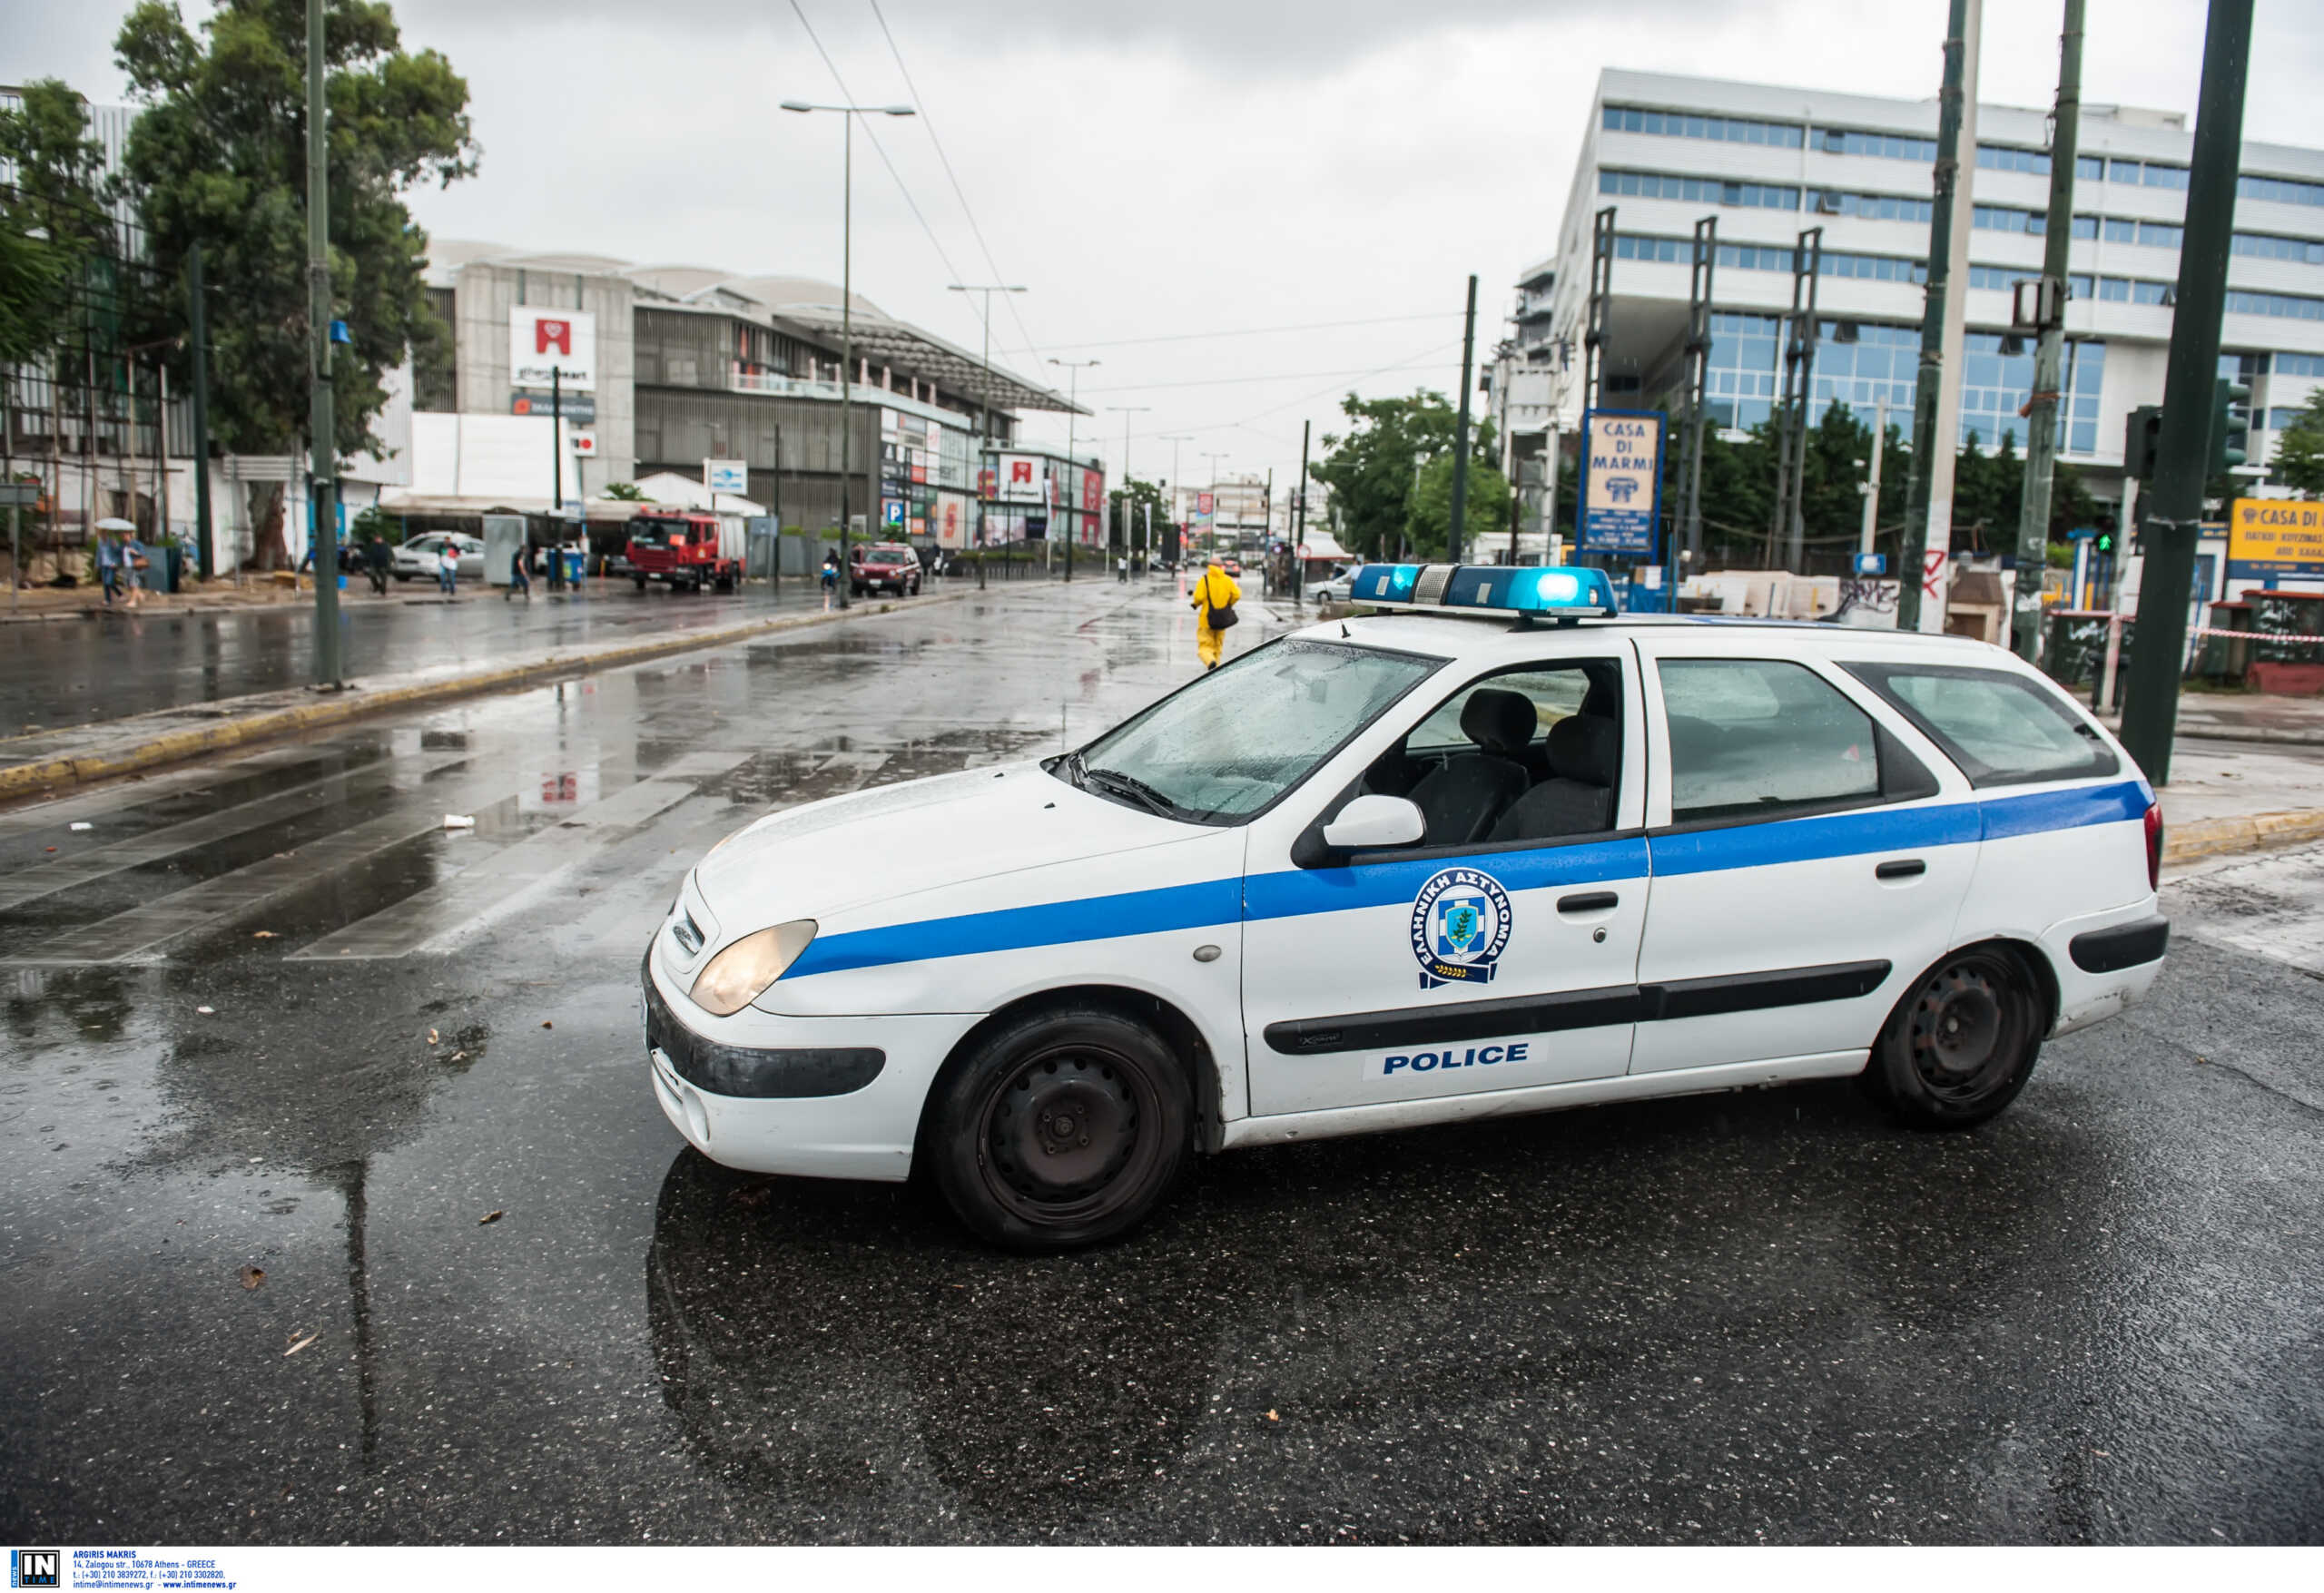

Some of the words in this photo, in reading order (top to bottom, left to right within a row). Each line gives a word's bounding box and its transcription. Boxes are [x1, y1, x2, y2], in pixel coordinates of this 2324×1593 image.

[1603, 422, 1646, 437] CASA
[1616, 439, 1633, 454] DI
[1592, 456, 1653, 470] MARMI
[890, 505, 901, 521] P
[2260, 508, 2298, 526] CASA
[2302, 510, 2318, 526] DI
[1413, 874, 1451, 966] ΕΛΛΗΝΙΚΗ
[1455, 871, 1510, 957] ΑΣΤΥΝΟΜΙΑ
[1383, 1043, 1529, 1075] POLICE
